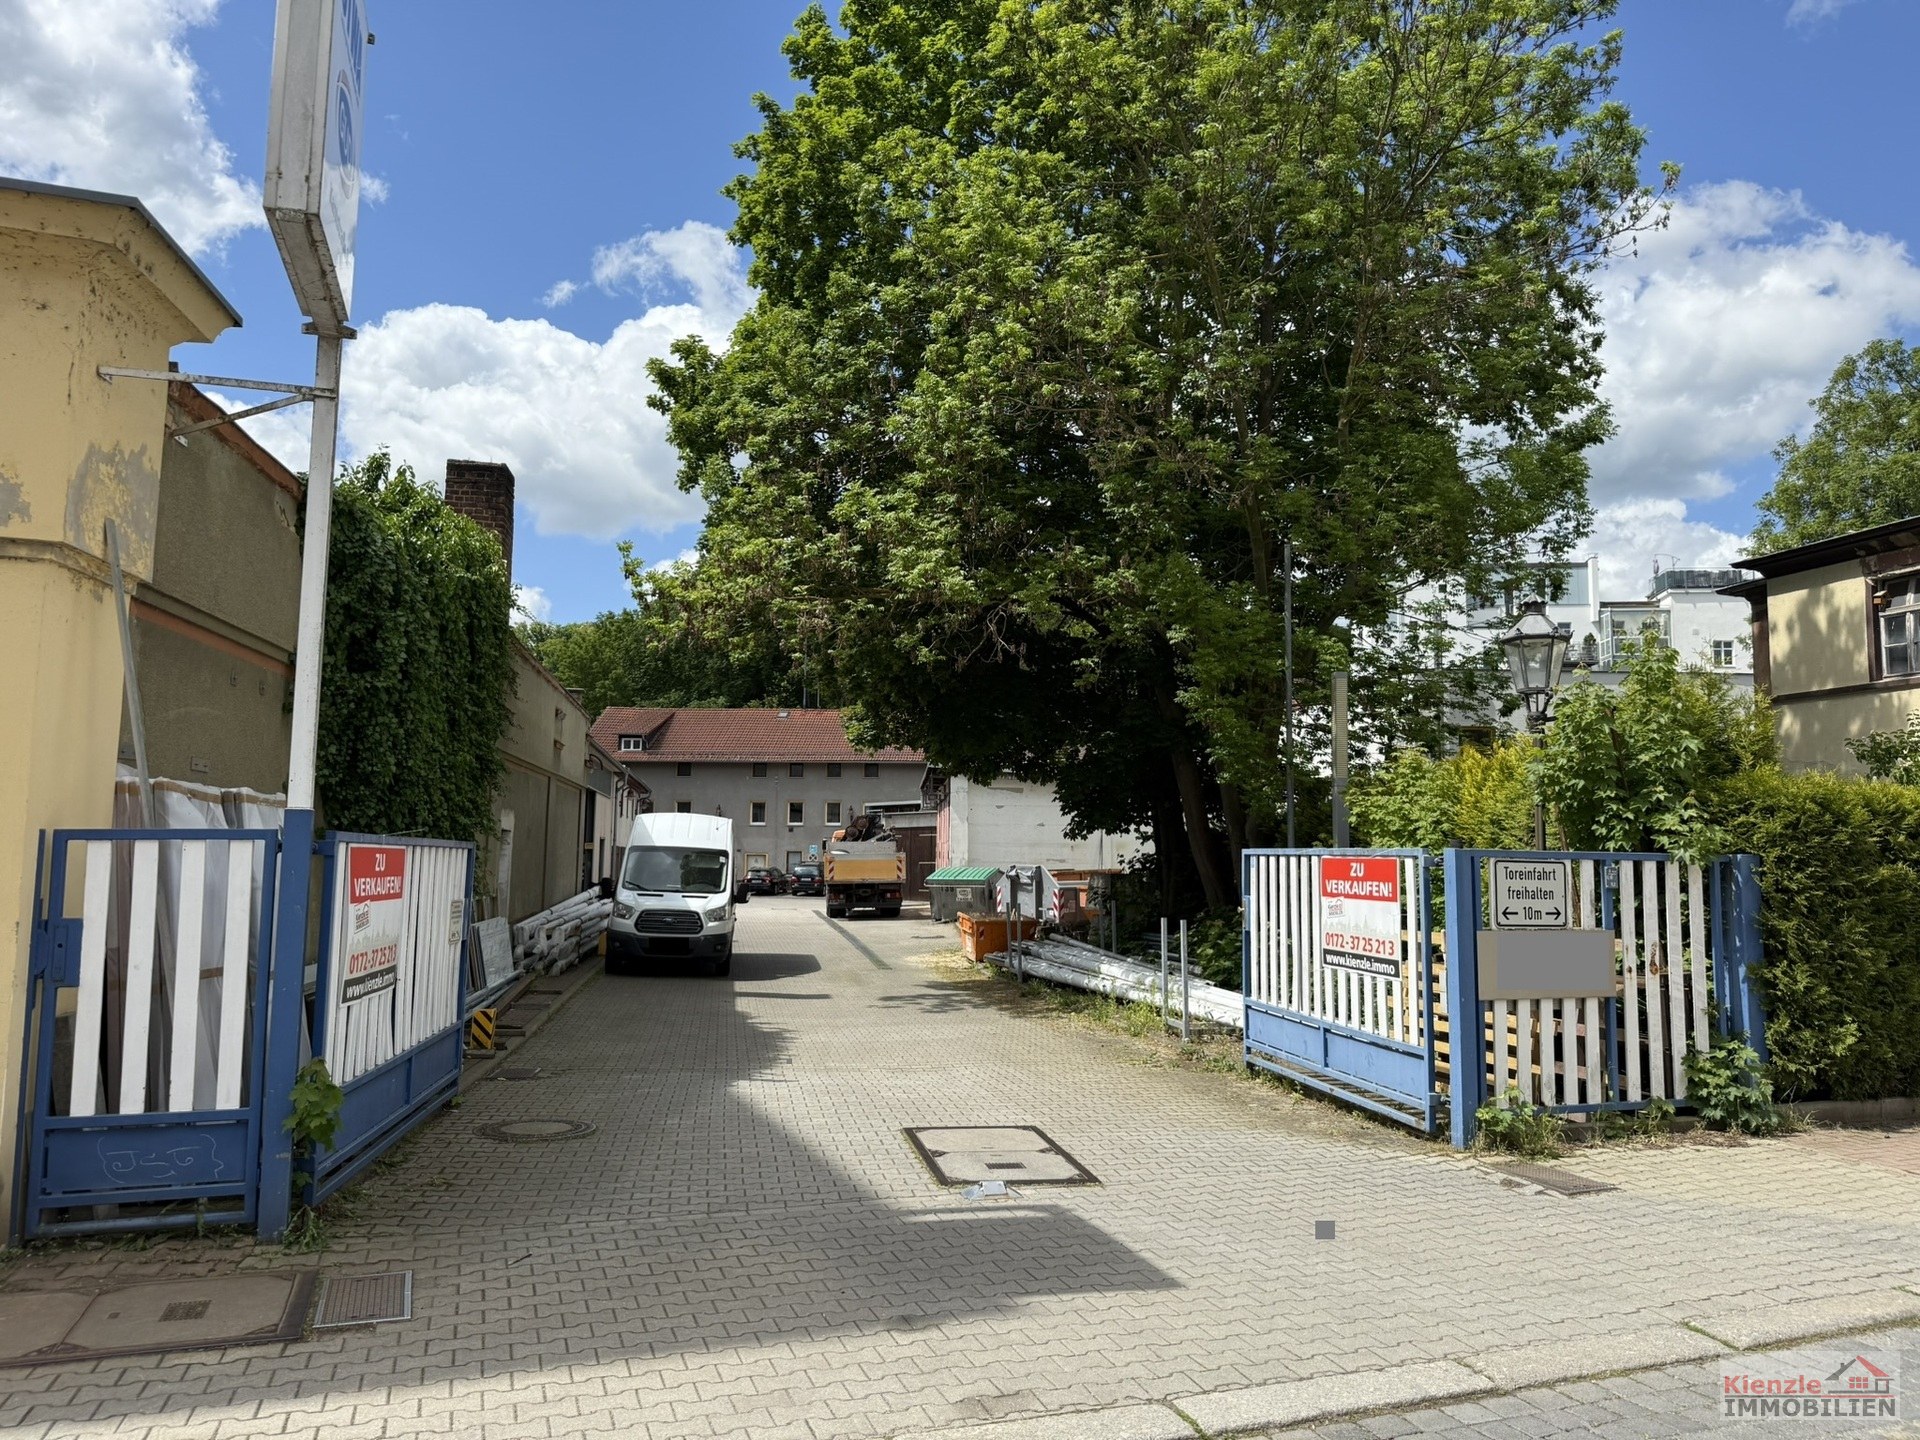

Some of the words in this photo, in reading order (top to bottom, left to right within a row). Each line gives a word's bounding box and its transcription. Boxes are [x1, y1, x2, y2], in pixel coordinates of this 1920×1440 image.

[375, 853, 386, 872] ZU
[1350, 863, 1364, 878] ZU
[1503, 866, 1557, 881] Toreinfahrt
[354, 877, 401, 896] VERKAUFEN!
[1325, 879, 1393, 897] VERKAUFEN!
[1507, 886, 1554, 900] freihalten
[1523, 906, 1542, 921] 10m
[1362, 936, 1373, 953] 25
[1325, 953, 1395, 975] www.kienzle.immo
